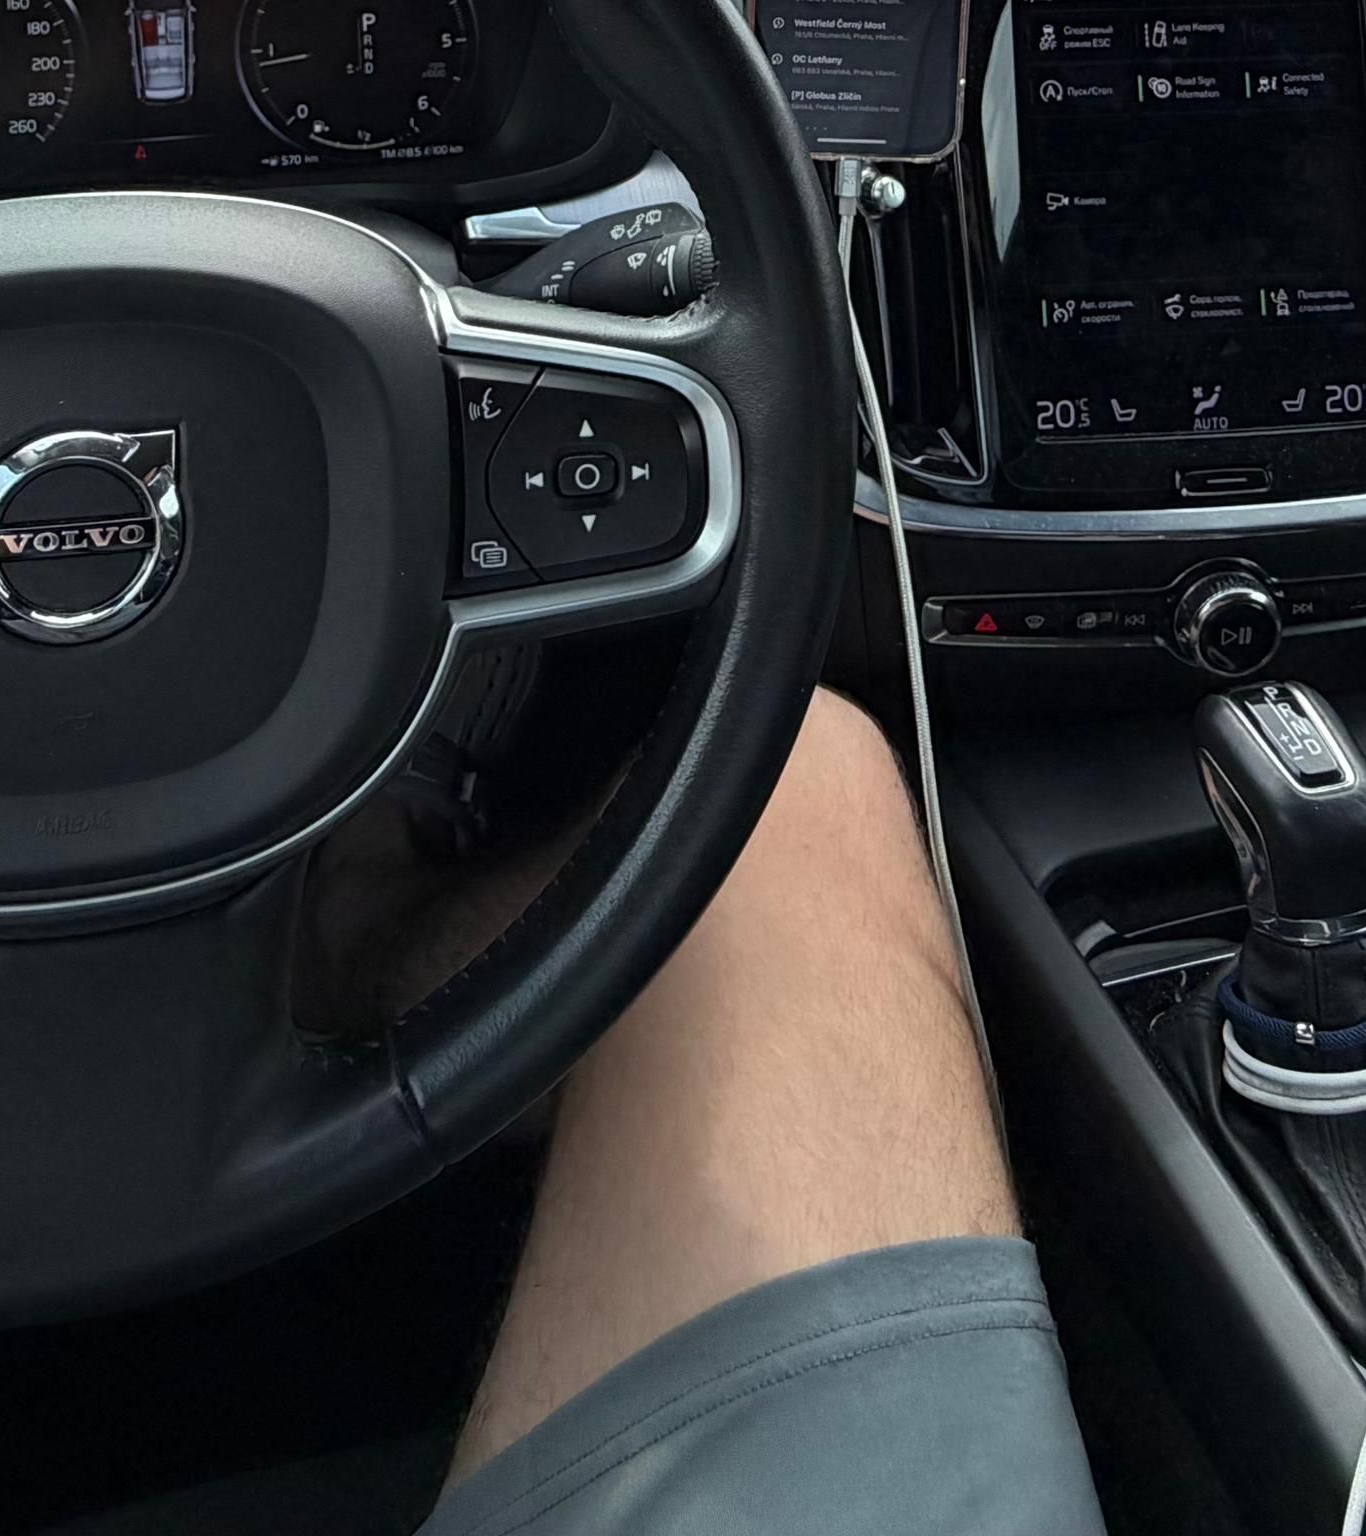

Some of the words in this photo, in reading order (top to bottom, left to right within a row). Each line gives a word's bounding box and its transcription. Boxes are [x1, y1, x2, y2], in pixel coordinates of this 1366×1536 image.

[26, 20, 51, 35] 180
[361, 13, 376, 32] P
[794, 18, 835, 29] Westfield
[836, 17, 863, 31] Černý
[863, 20, 887, 30] Most
[441, 33, 453, 48] 5
[1092, 37, 1112, 48] ESC
[31, 56, 60, 71] 200
[792, 54, 807, 64] OC
[807, 55, 843, 66] Letňany
[1282, 72, 1325, 83] Connected
[791, 91, 805, 101] [P]
[805, 91, 836, 101] Globus
[1175, 89, 1221, 100] Information
[1283, 85, 1309, 97] Safety
[27, 92, 56, 107] 230
[417, 94, 429, 110] 6
[296, 103, 309, 119] 0
[8, 119, 37, 134] 260
[280, 154, 303, 166] 570
[541, 285, 559, 298] INT
[1193, 416, 1229, 431] AUTO
[0, 524, 145, 554] VOLVO
[1263, 686, 1279, 700] P
[1277, 702, 1294, 718] R
[1290, 721, 1311, 736] N
[1304, 740, 1322, 755] D
